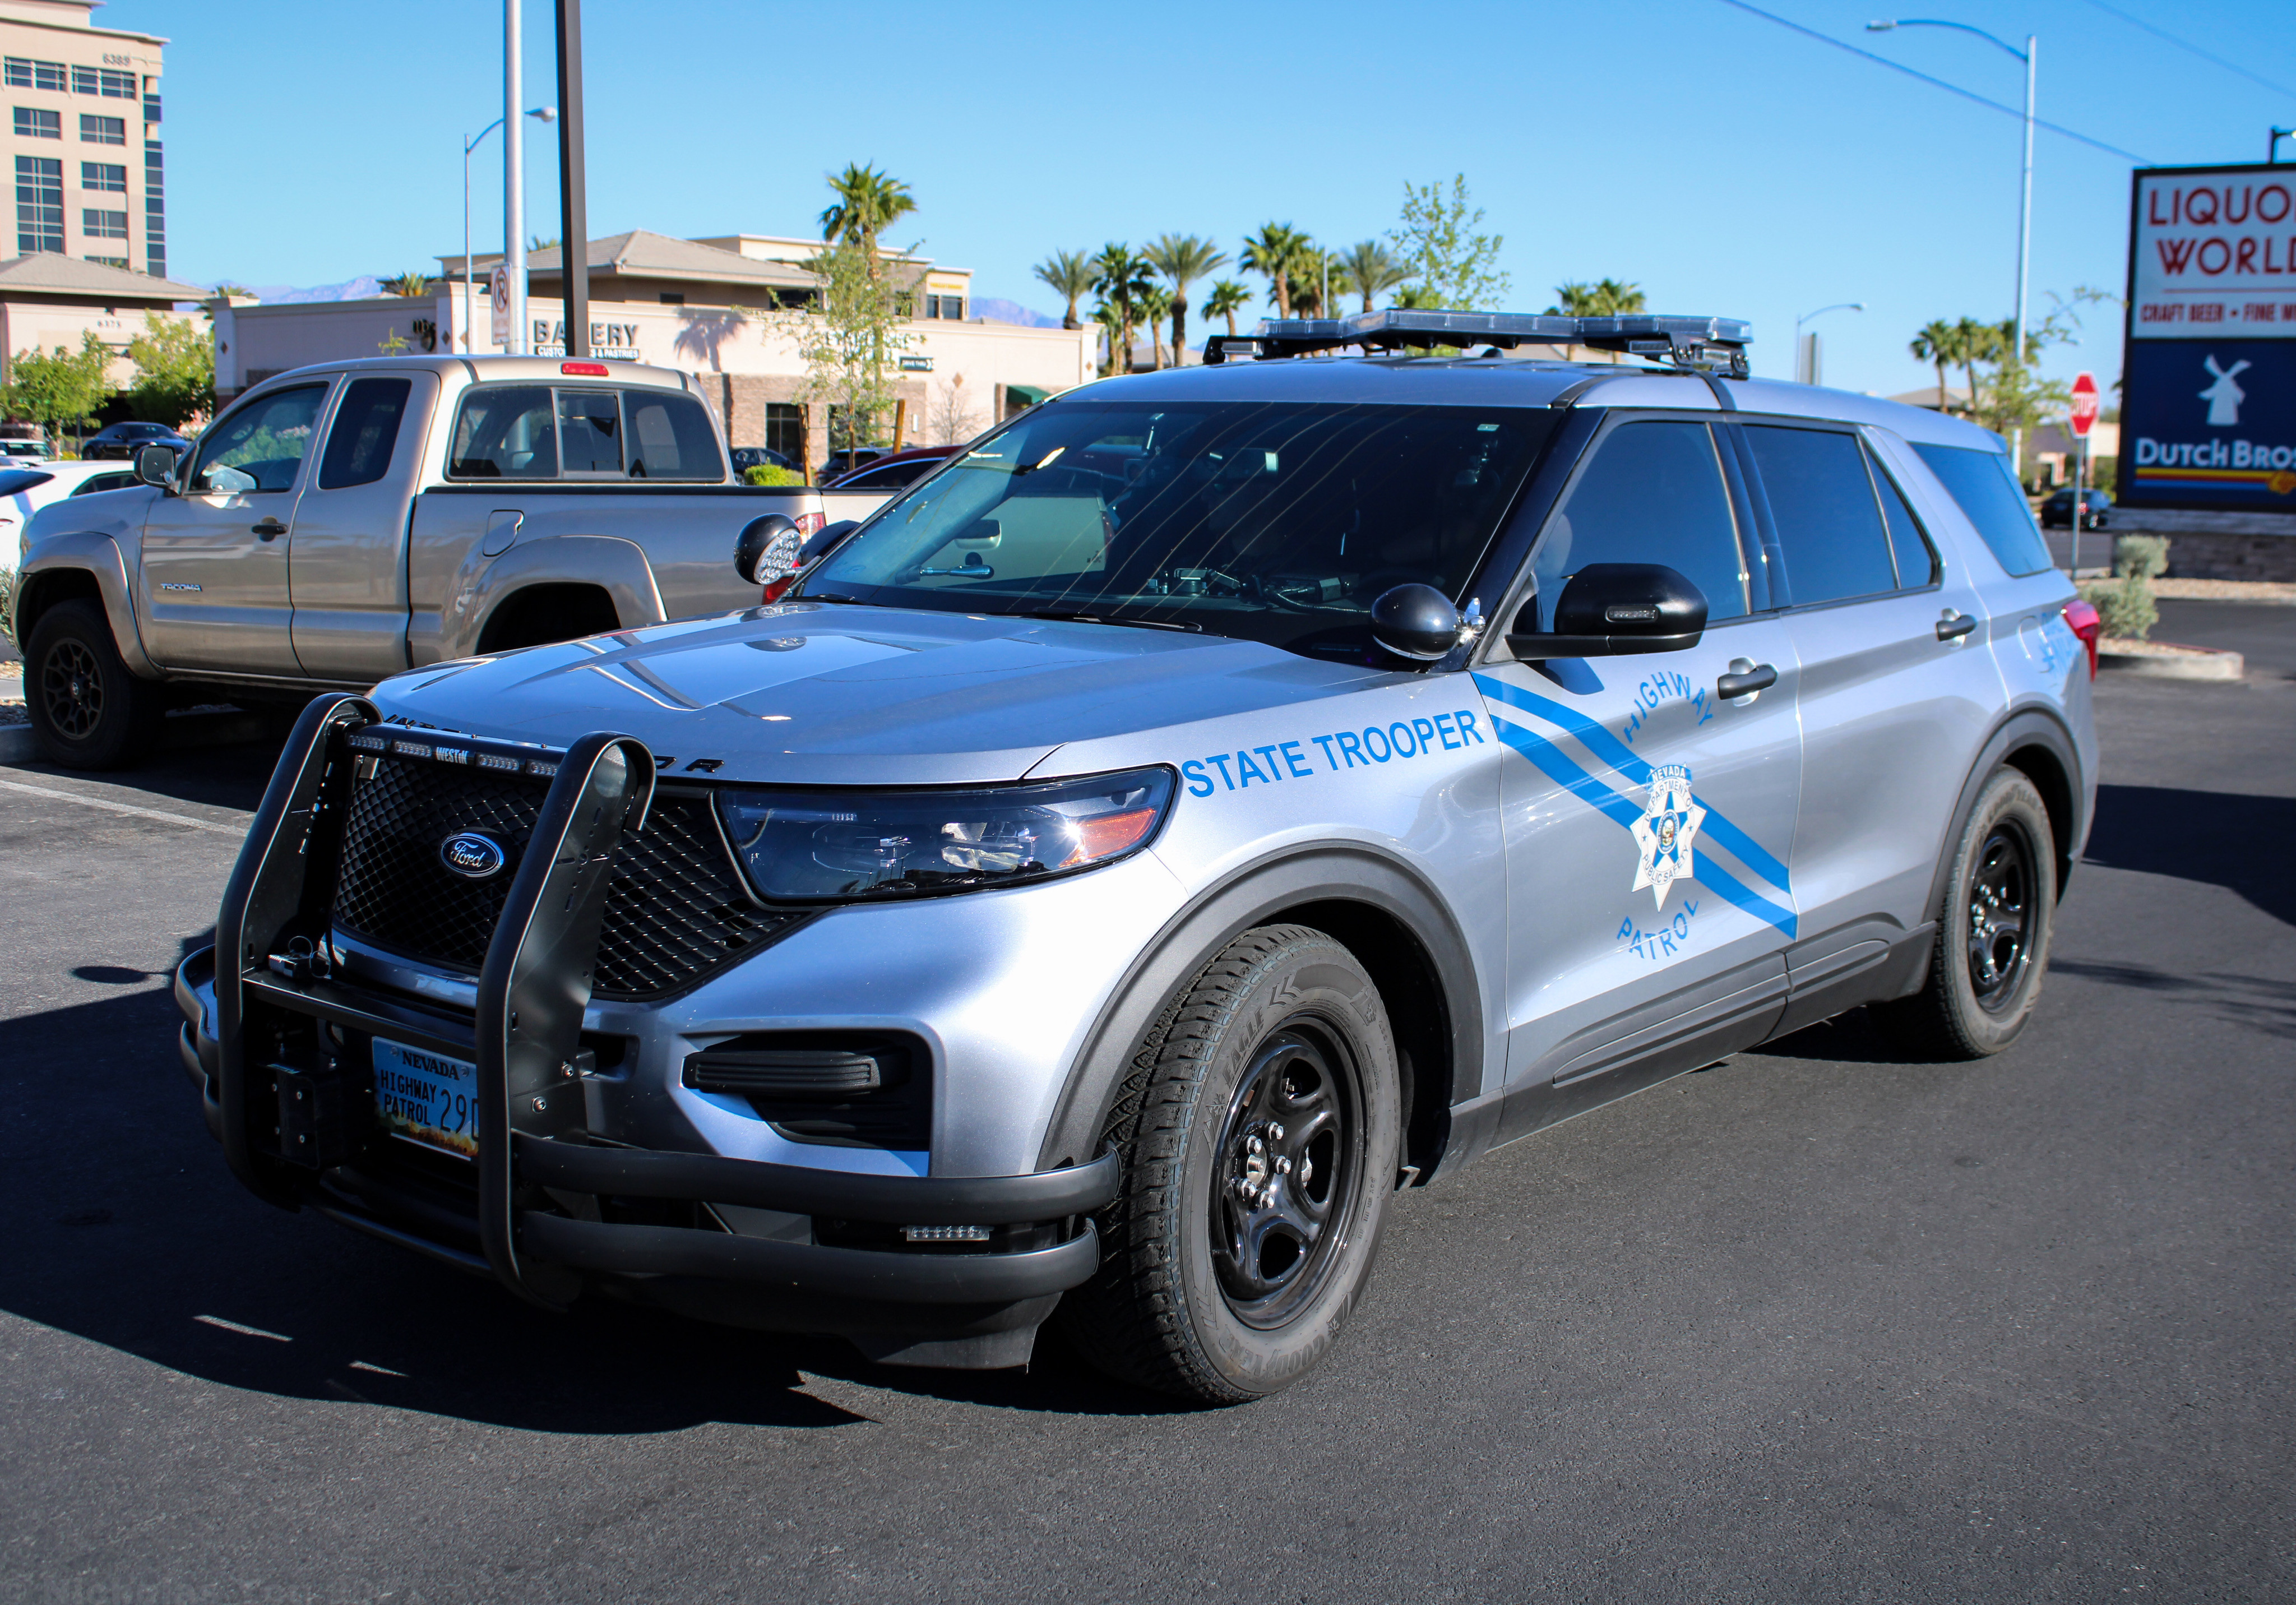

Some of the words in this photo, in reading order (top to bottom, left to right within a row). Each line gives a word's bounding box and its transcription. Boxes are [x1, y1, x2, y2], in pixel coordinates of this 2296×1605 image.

[2149, 184, 2296, 226] LIQUO
[2141, 304, 2184, 322] CRAFT
[2189, 303, 2223, 322] BEER
[2243, 303, 2275, 322] FINE
[534, 319, 638, 346] BAERY
[538, 346, 566, 358] CUSTO
[604, 349, 638, 359] PASTRIES
[2070, 392, 2098, 417] STOP
[160, 583, 202, 592] TACOMA
[1623, 671, 1713, 744] HIGHWAY
[1181, 741, 1314, 798] STATE
[1311, 710, 1485, 771] TROOPER
[1651, 765, 1686, 781] NEVADA
[1645, 778, 1688, 822] DEPARTMENT
[1686, 798, 1695, 813] OF
[450, 841, 487, 868] Ford
[1643, 853, 1663, 884] PUBLIC
[1663, 846, 1689, 883] SAFETY
[1617, 900, 1699, 960] PATROL
[1222, 1006, 1265, 1086] EAGLE
[402, 1051, 460, 1081] NEVADA
[381, 1069, 437, 1104] HIGHWAY
[385, 1094, 431, 1126] PATROL
